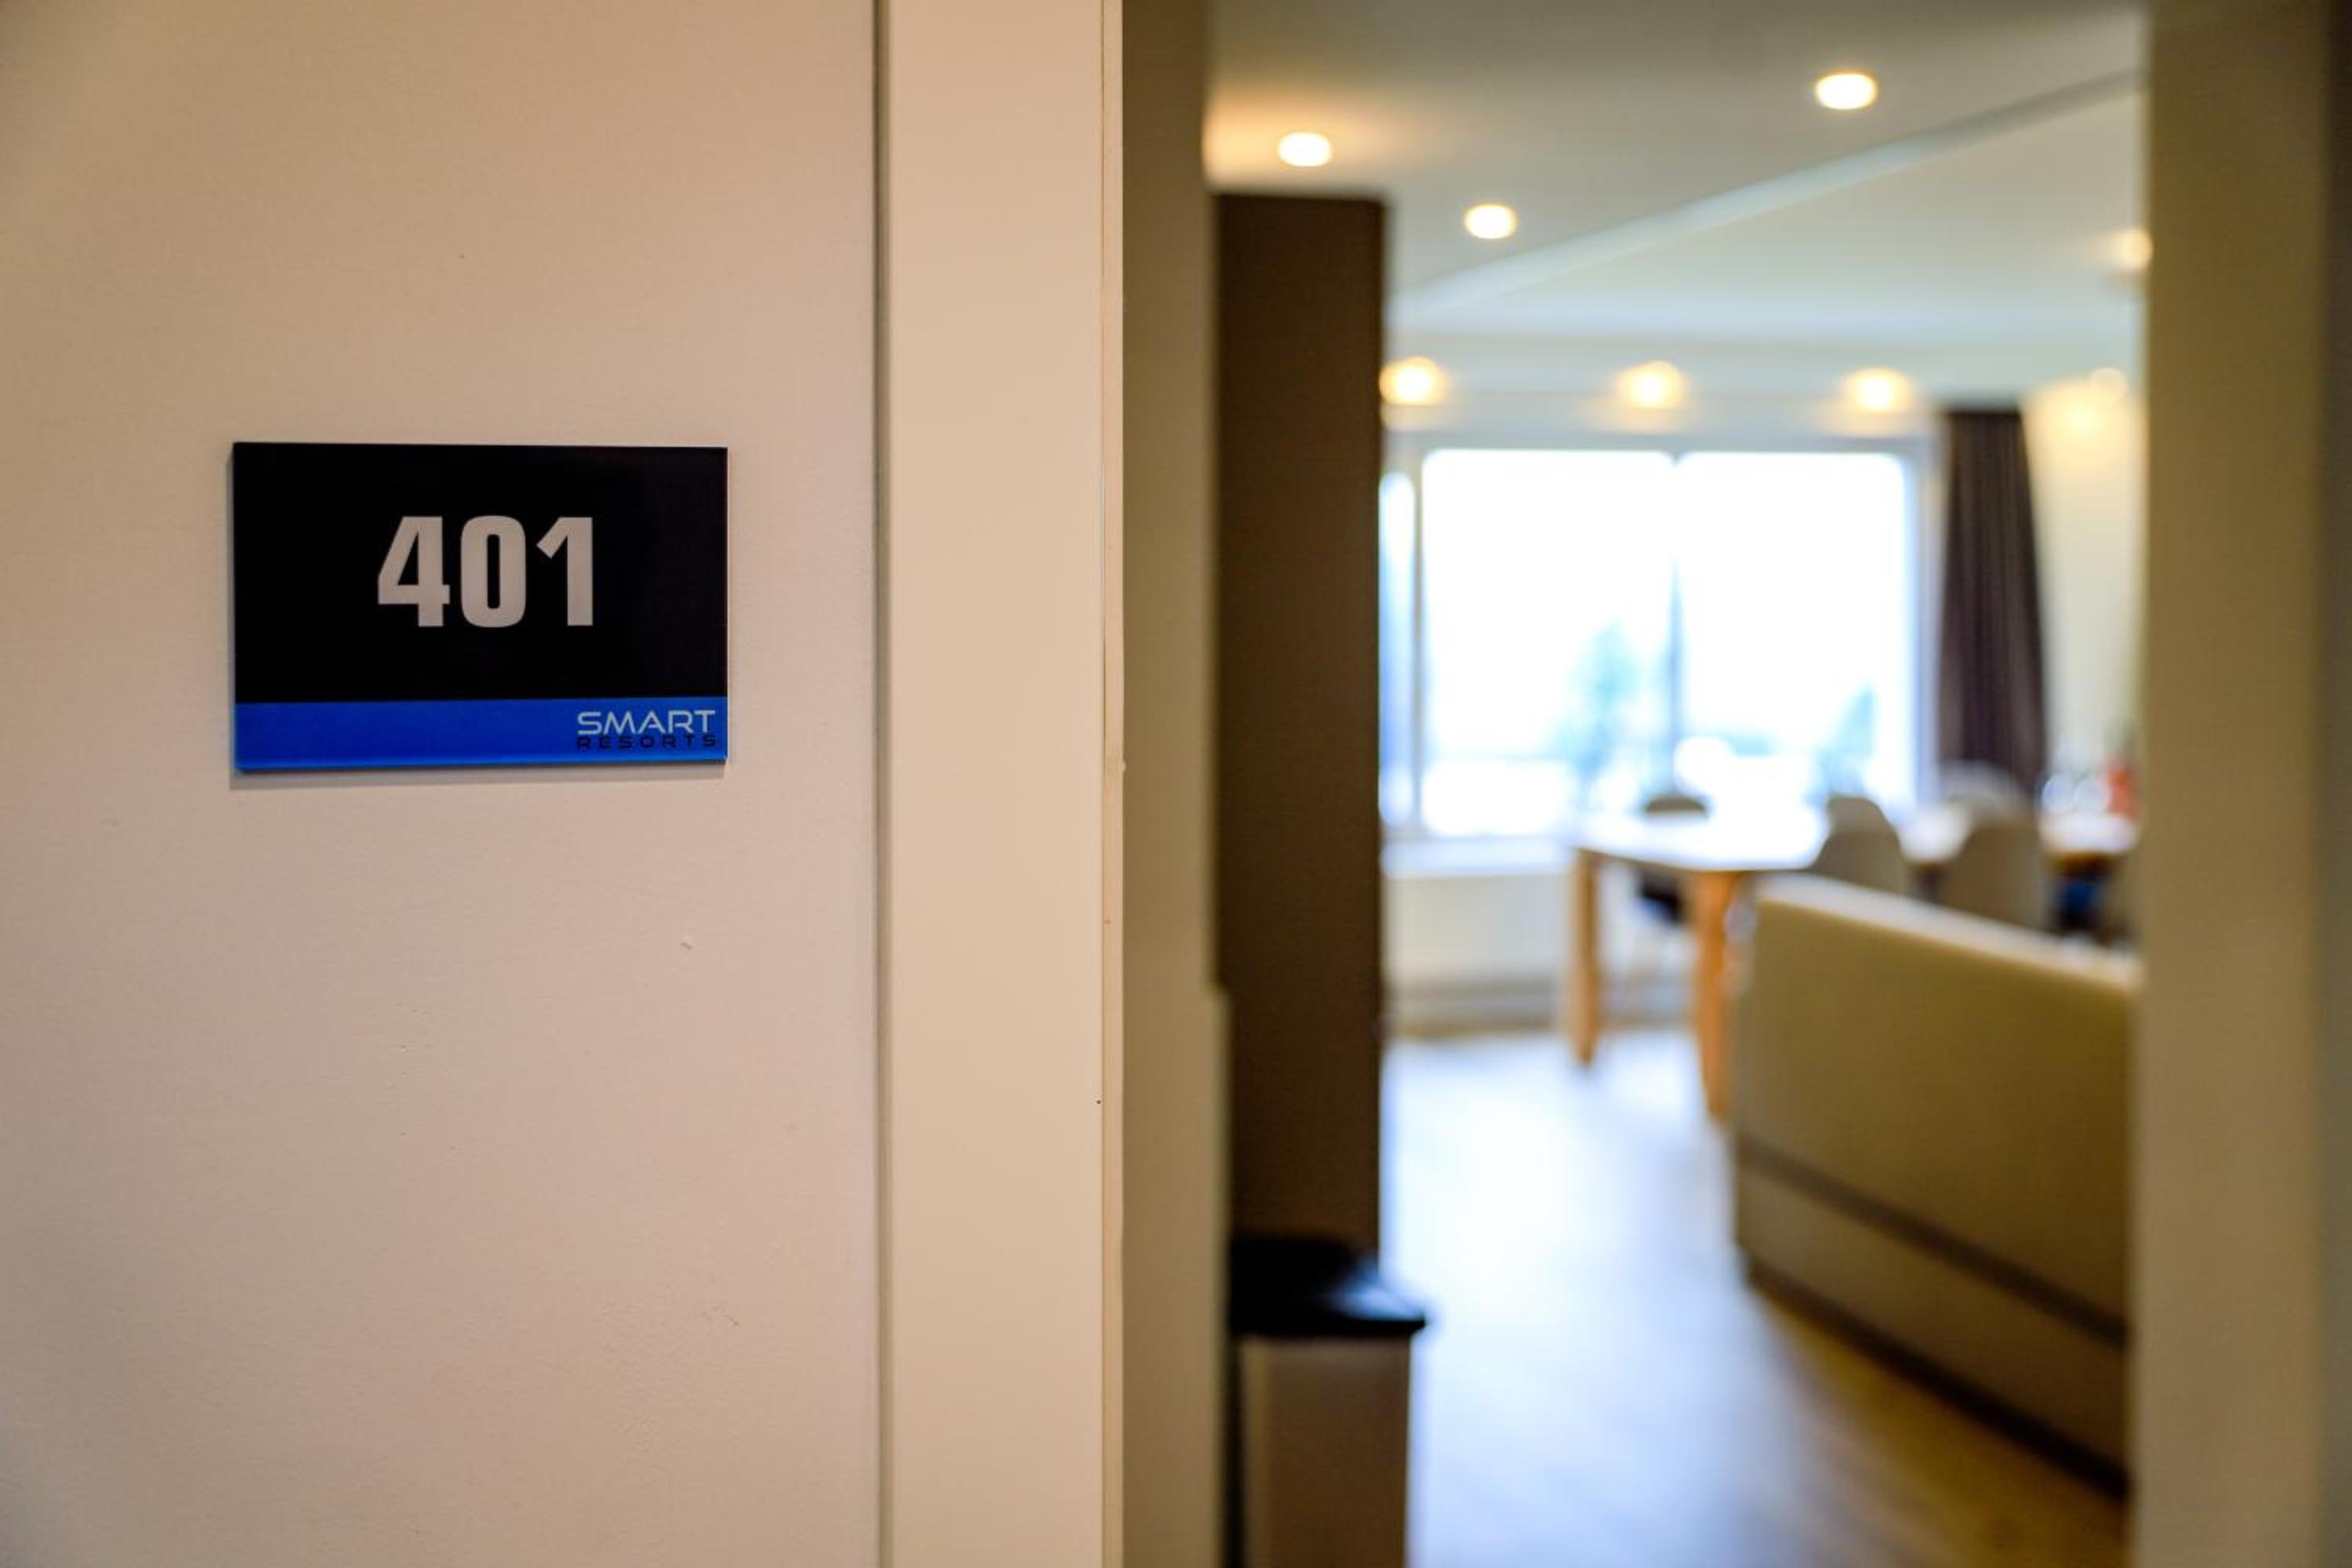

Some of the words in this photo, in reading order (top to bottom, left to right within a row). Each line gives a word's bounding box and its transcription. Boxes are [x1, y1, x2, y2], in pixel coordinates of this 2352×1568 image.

[377, 515, 593, 628] 401
[577, 710, 716, 735] SMART
[576, 734, 716, 750] RESORTS
